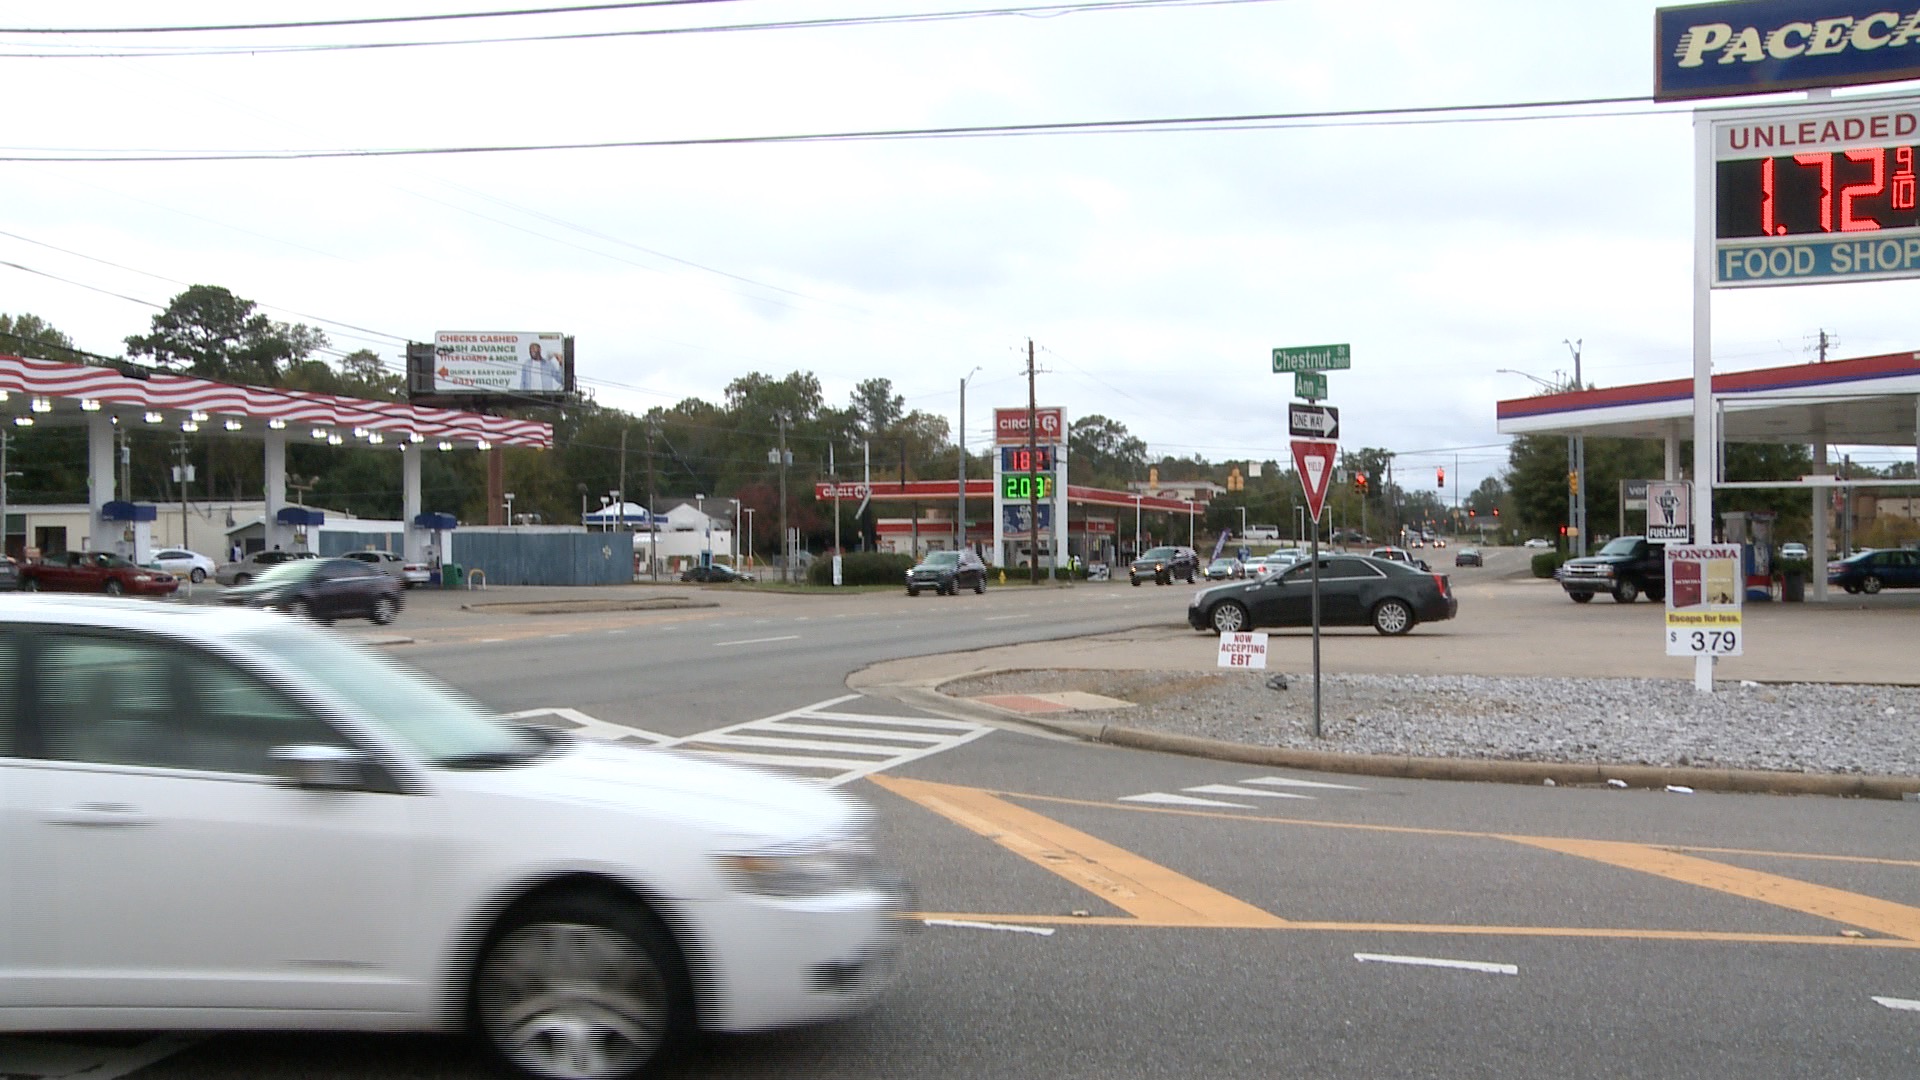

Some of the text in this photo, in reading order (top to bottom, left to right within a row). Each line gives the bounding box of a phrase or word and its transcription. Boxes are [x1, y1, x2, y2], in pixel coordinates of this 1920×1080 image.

[1730, 113, 1917, 149] UNLEADED
[1762, 147, 1885, 236] 1.72
[1725, 239, 1920, 278] FOOD SHOP
[440, 335, 518, 343] CHECKS CASHED
[470, 345, 516, 353] ADVANCE
[1274, 346, 1345, 370] Chestnut St
[452, 377, 511, 386] easymoney
[1296, 376, 1314, 395] Ann
[1294, 414, 1324, 429] ONE WAY
[1307, 461, 1322, 472] YIELD
[1649, 527, 1686, 538] FUELMAN
[1668, 549, 1738, 559] SONOMA
[1669, 614, 1702, 623] Escape
[1704, 614, 1717, 622] for
[1234, 634, 1252, 643] NOW
[1670, 631, 1677, 642] $
[1221, 643, 1265, 654] ACCEPTING
[1230, 653, 1251, 666] EBT
